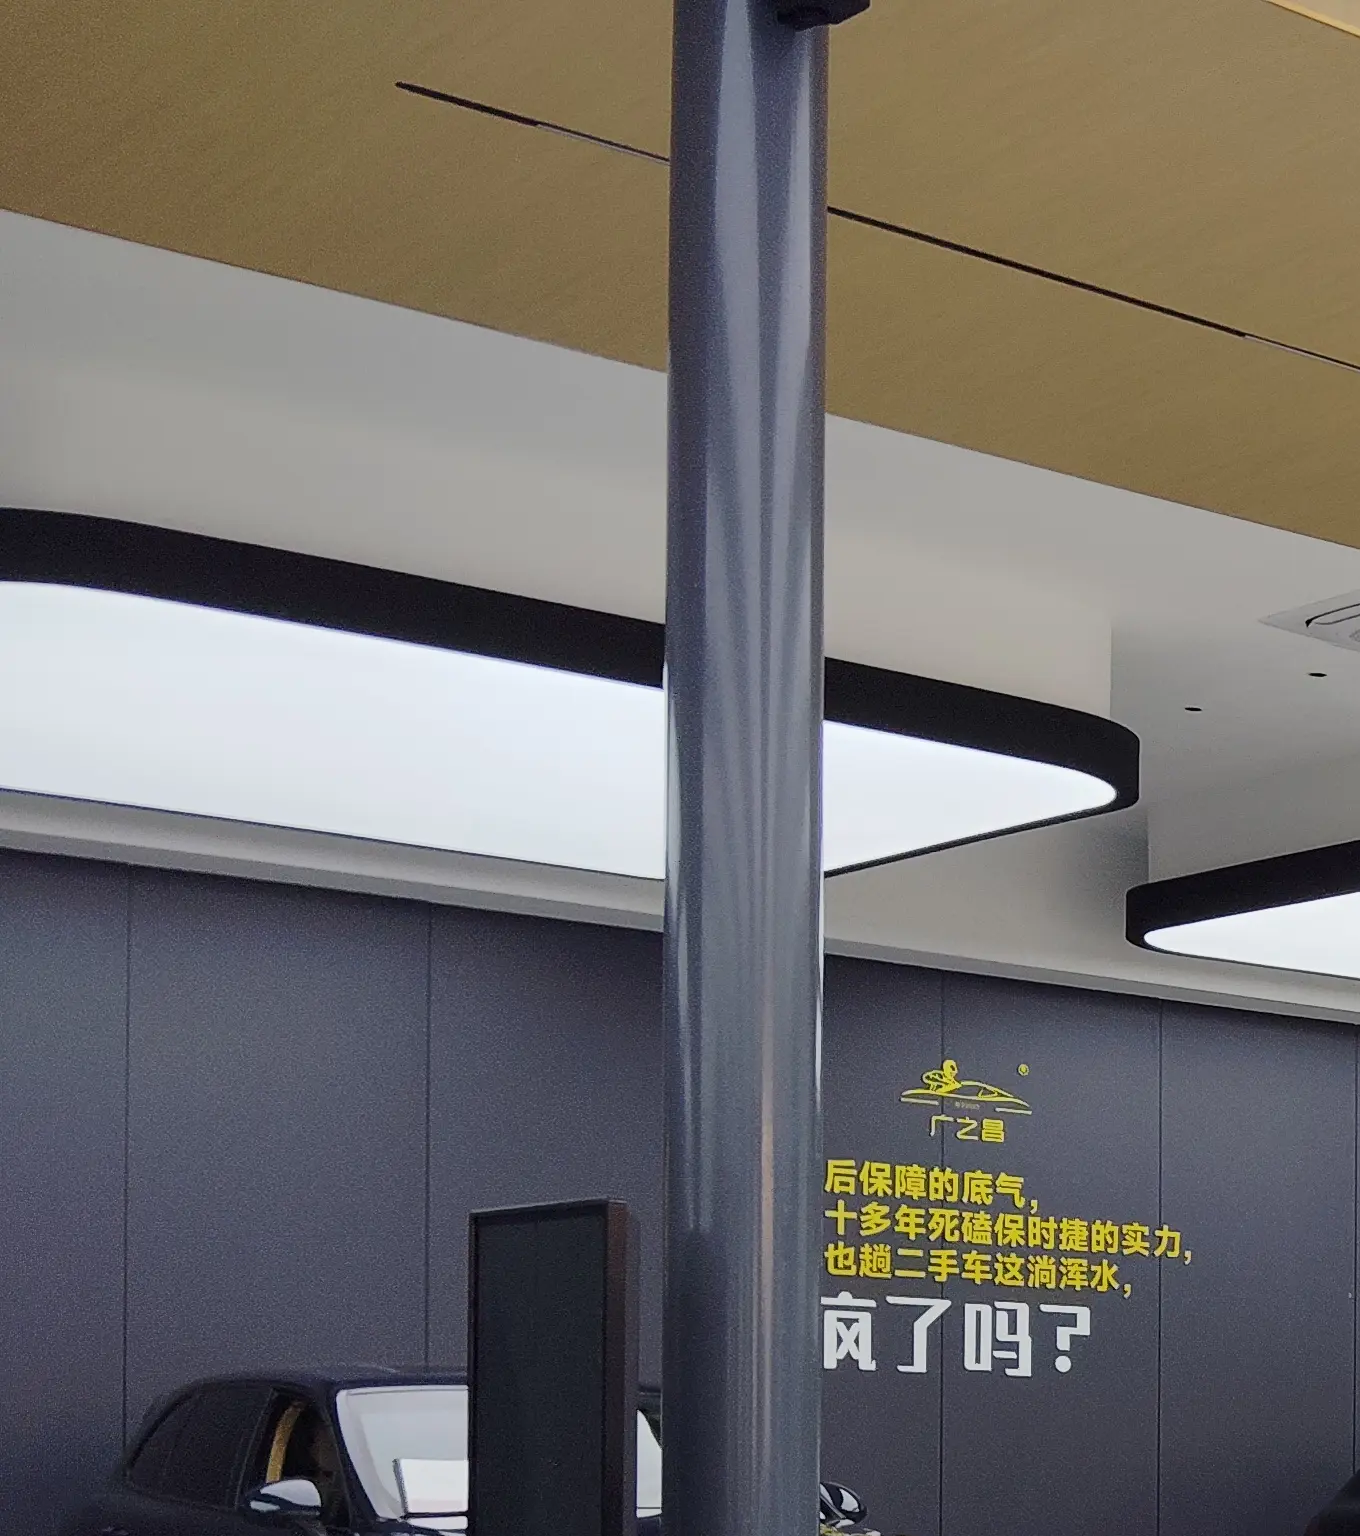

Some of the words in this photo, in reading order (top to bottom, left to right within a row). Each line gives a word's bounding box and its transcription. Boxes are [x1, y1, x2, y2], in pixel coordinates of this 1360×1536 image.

[824, 1199, 1192, 1265] 十多年死磕保时捷的实力，
